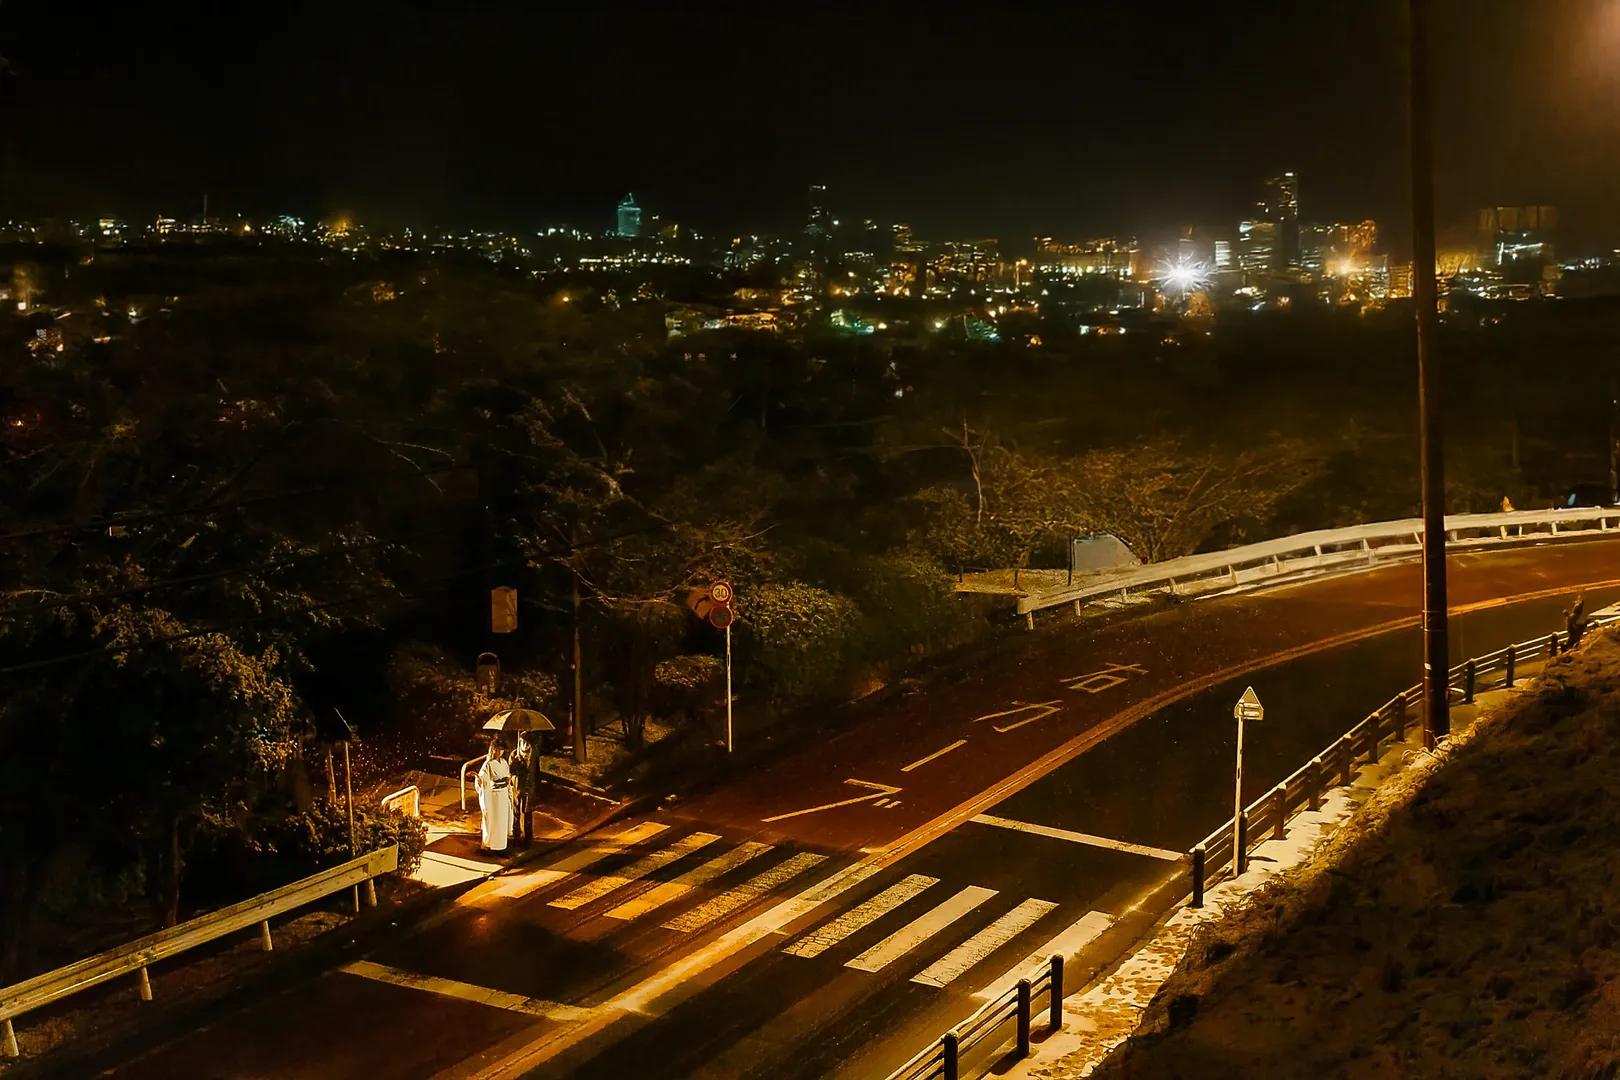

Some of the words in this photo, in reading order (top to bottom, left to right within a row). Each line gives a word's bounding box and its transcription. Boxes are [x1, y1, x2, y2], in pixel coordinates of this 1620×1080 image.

[714, 588, 728, 599] 30
[761, 662, 1149, 822] 右カーブ
